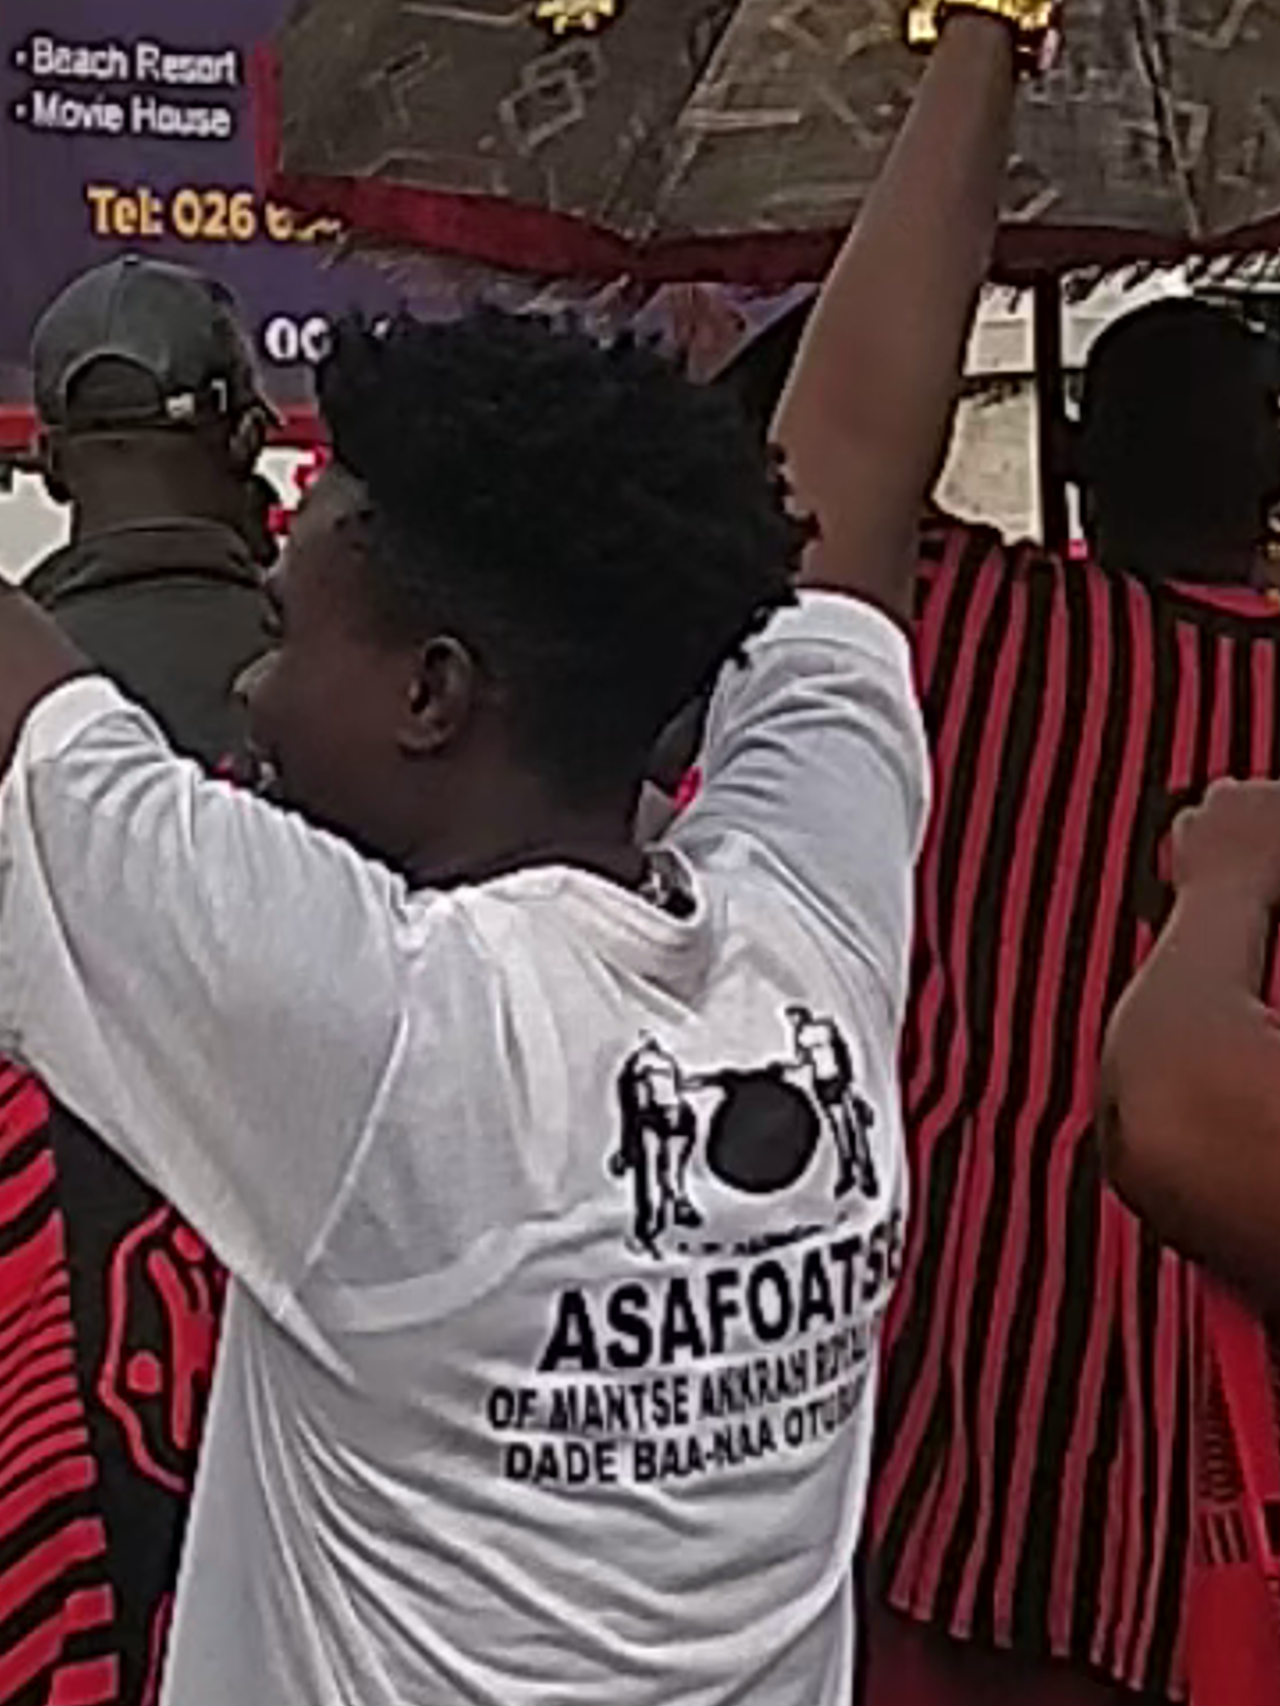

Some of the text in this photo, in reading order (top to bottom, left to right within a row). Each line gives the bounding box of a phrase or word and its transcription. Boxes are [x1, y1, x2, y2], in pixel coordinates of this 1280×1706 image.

[33, 36, 236, 85] Beach Resort
[32, 90, 232, 138] Movie House
[172, 188, 255, 238] 026
[488, 1385, 537, 1431] OF
[549, 1375, 689, 1433] MANTSE
[506, 1441, 617, 1484] DADE
